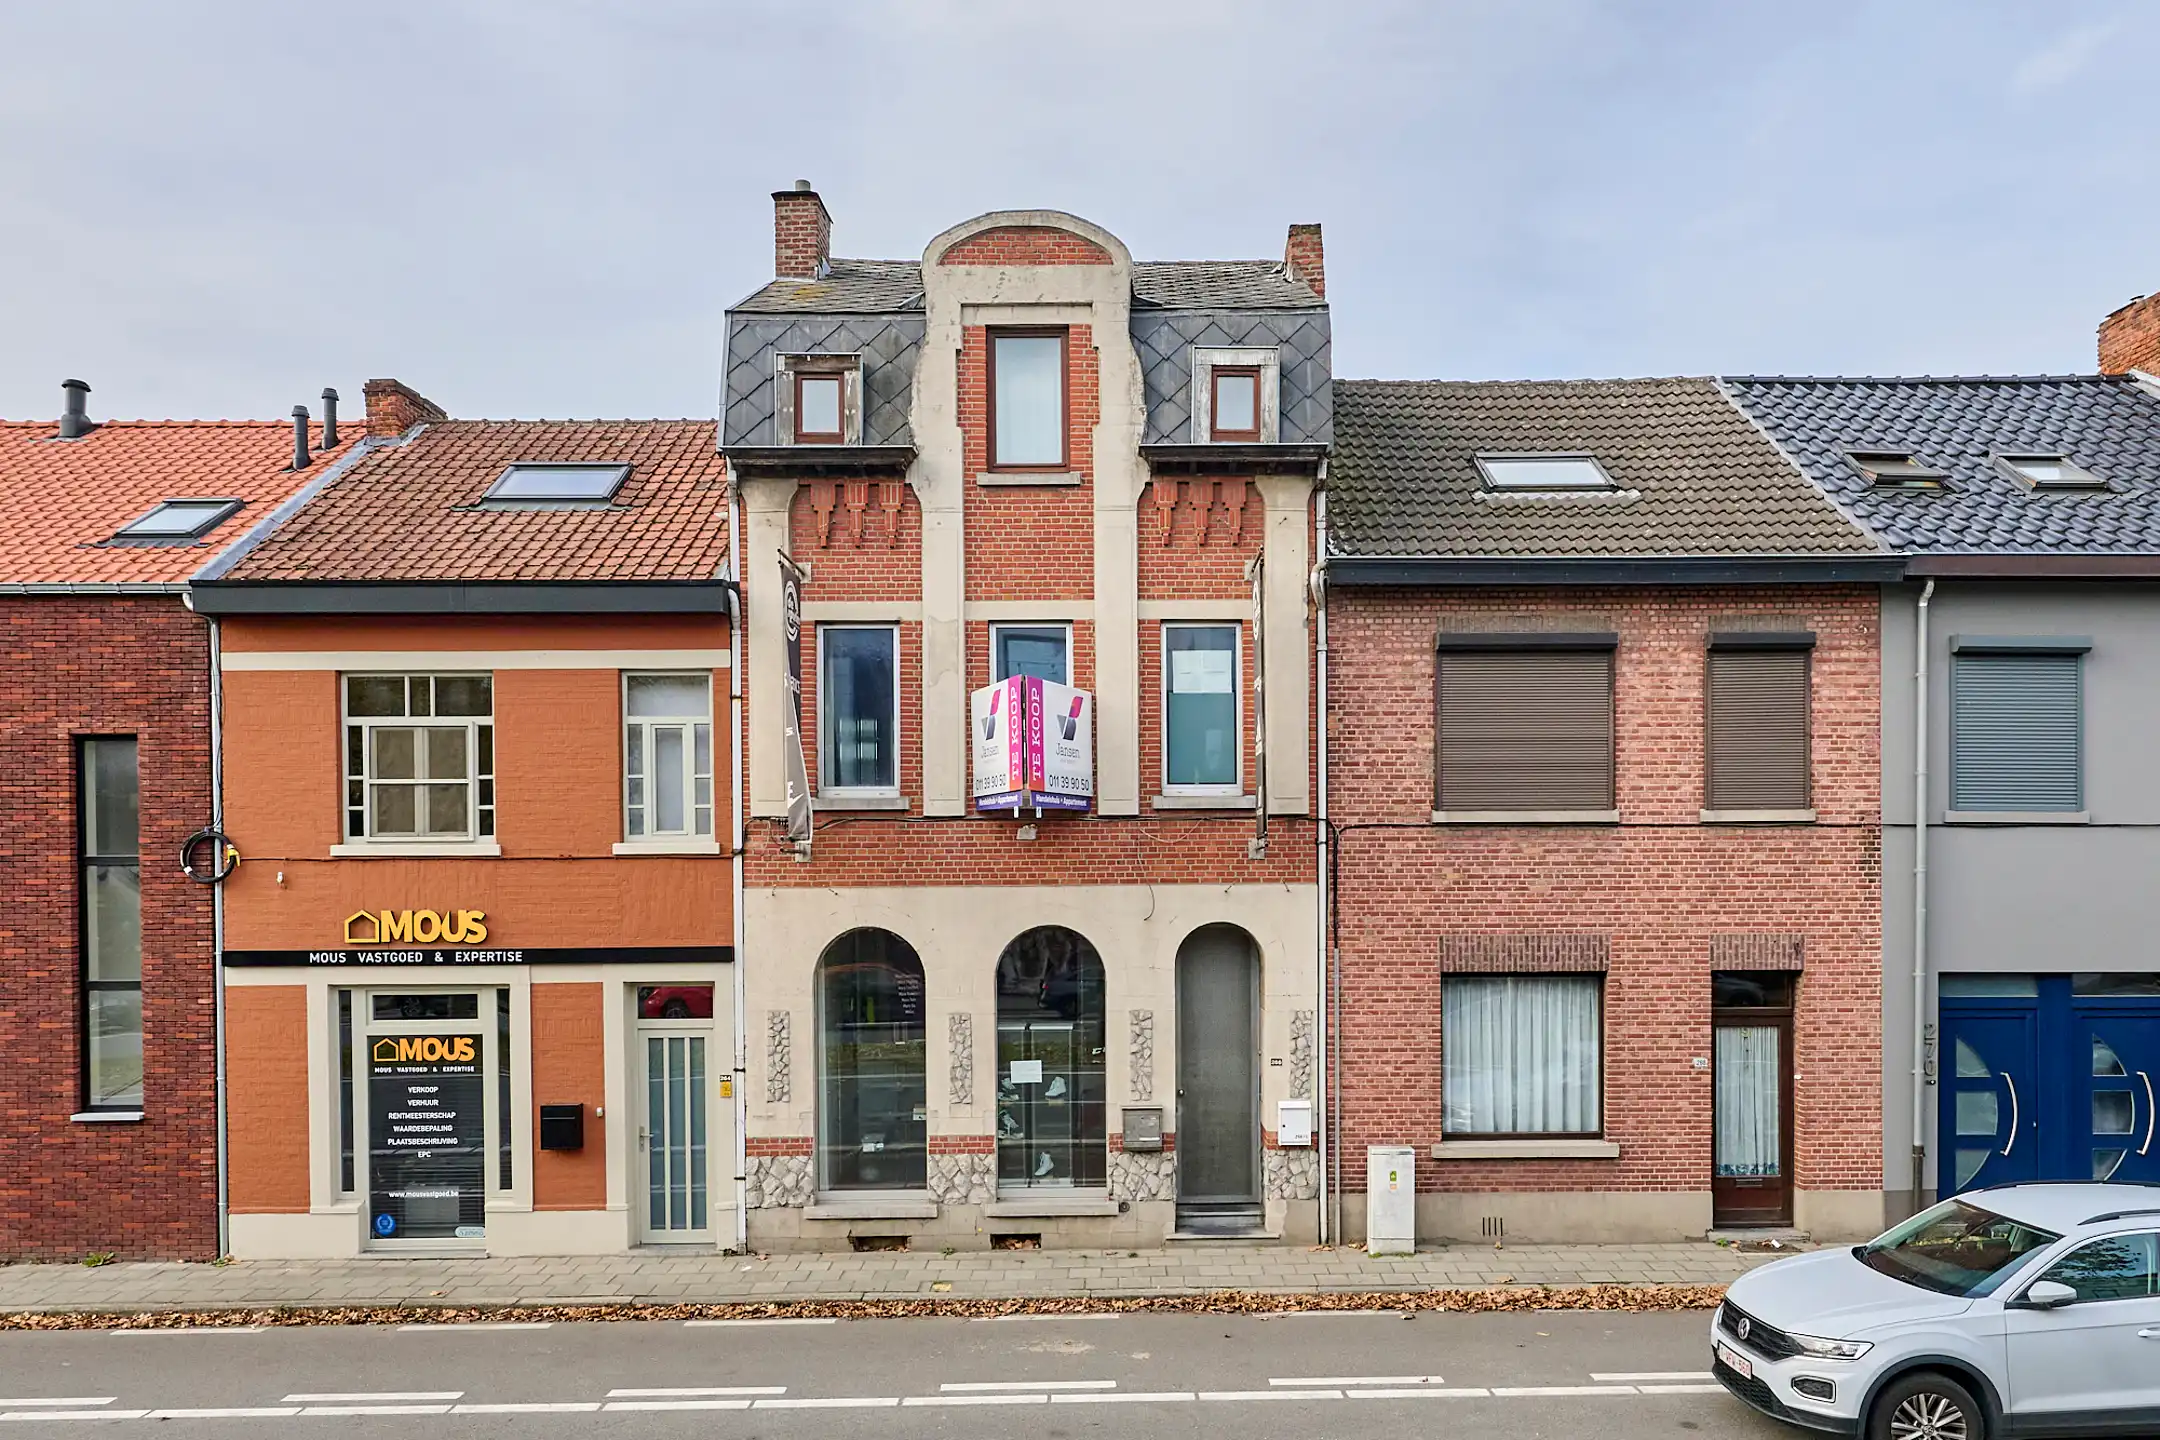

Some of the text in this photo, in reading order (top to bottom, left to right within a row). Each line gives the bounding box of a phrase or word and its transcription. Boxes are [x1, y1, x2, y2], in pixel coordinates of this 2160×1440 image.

[1010, 686, 1019, 780] TE KOOP
[1031, 687, 1041, 781] TE KOOP
[1056, 742, 1081, 759] Jansen
[1049, 774, 1089, 791] 011 39 90 50
[380, 909, 488, 944] MOUS
[309, 951, 523, 963] MOUS VASTGOED & EXPERTISE
[399, 1037, 475, 1062] MOUS
[442, 1065, 475, 1073] EXPERTISE
[407, 1099, 439, 1107] VERHUUR
[388, 1111, 457, 1119] RENTMEESTERSCHAP
[387, 1137, 458, 1145] PLAATSBESCHRIJVING
[388, 1190, 459, 1198] www.mousvastgoed.be
